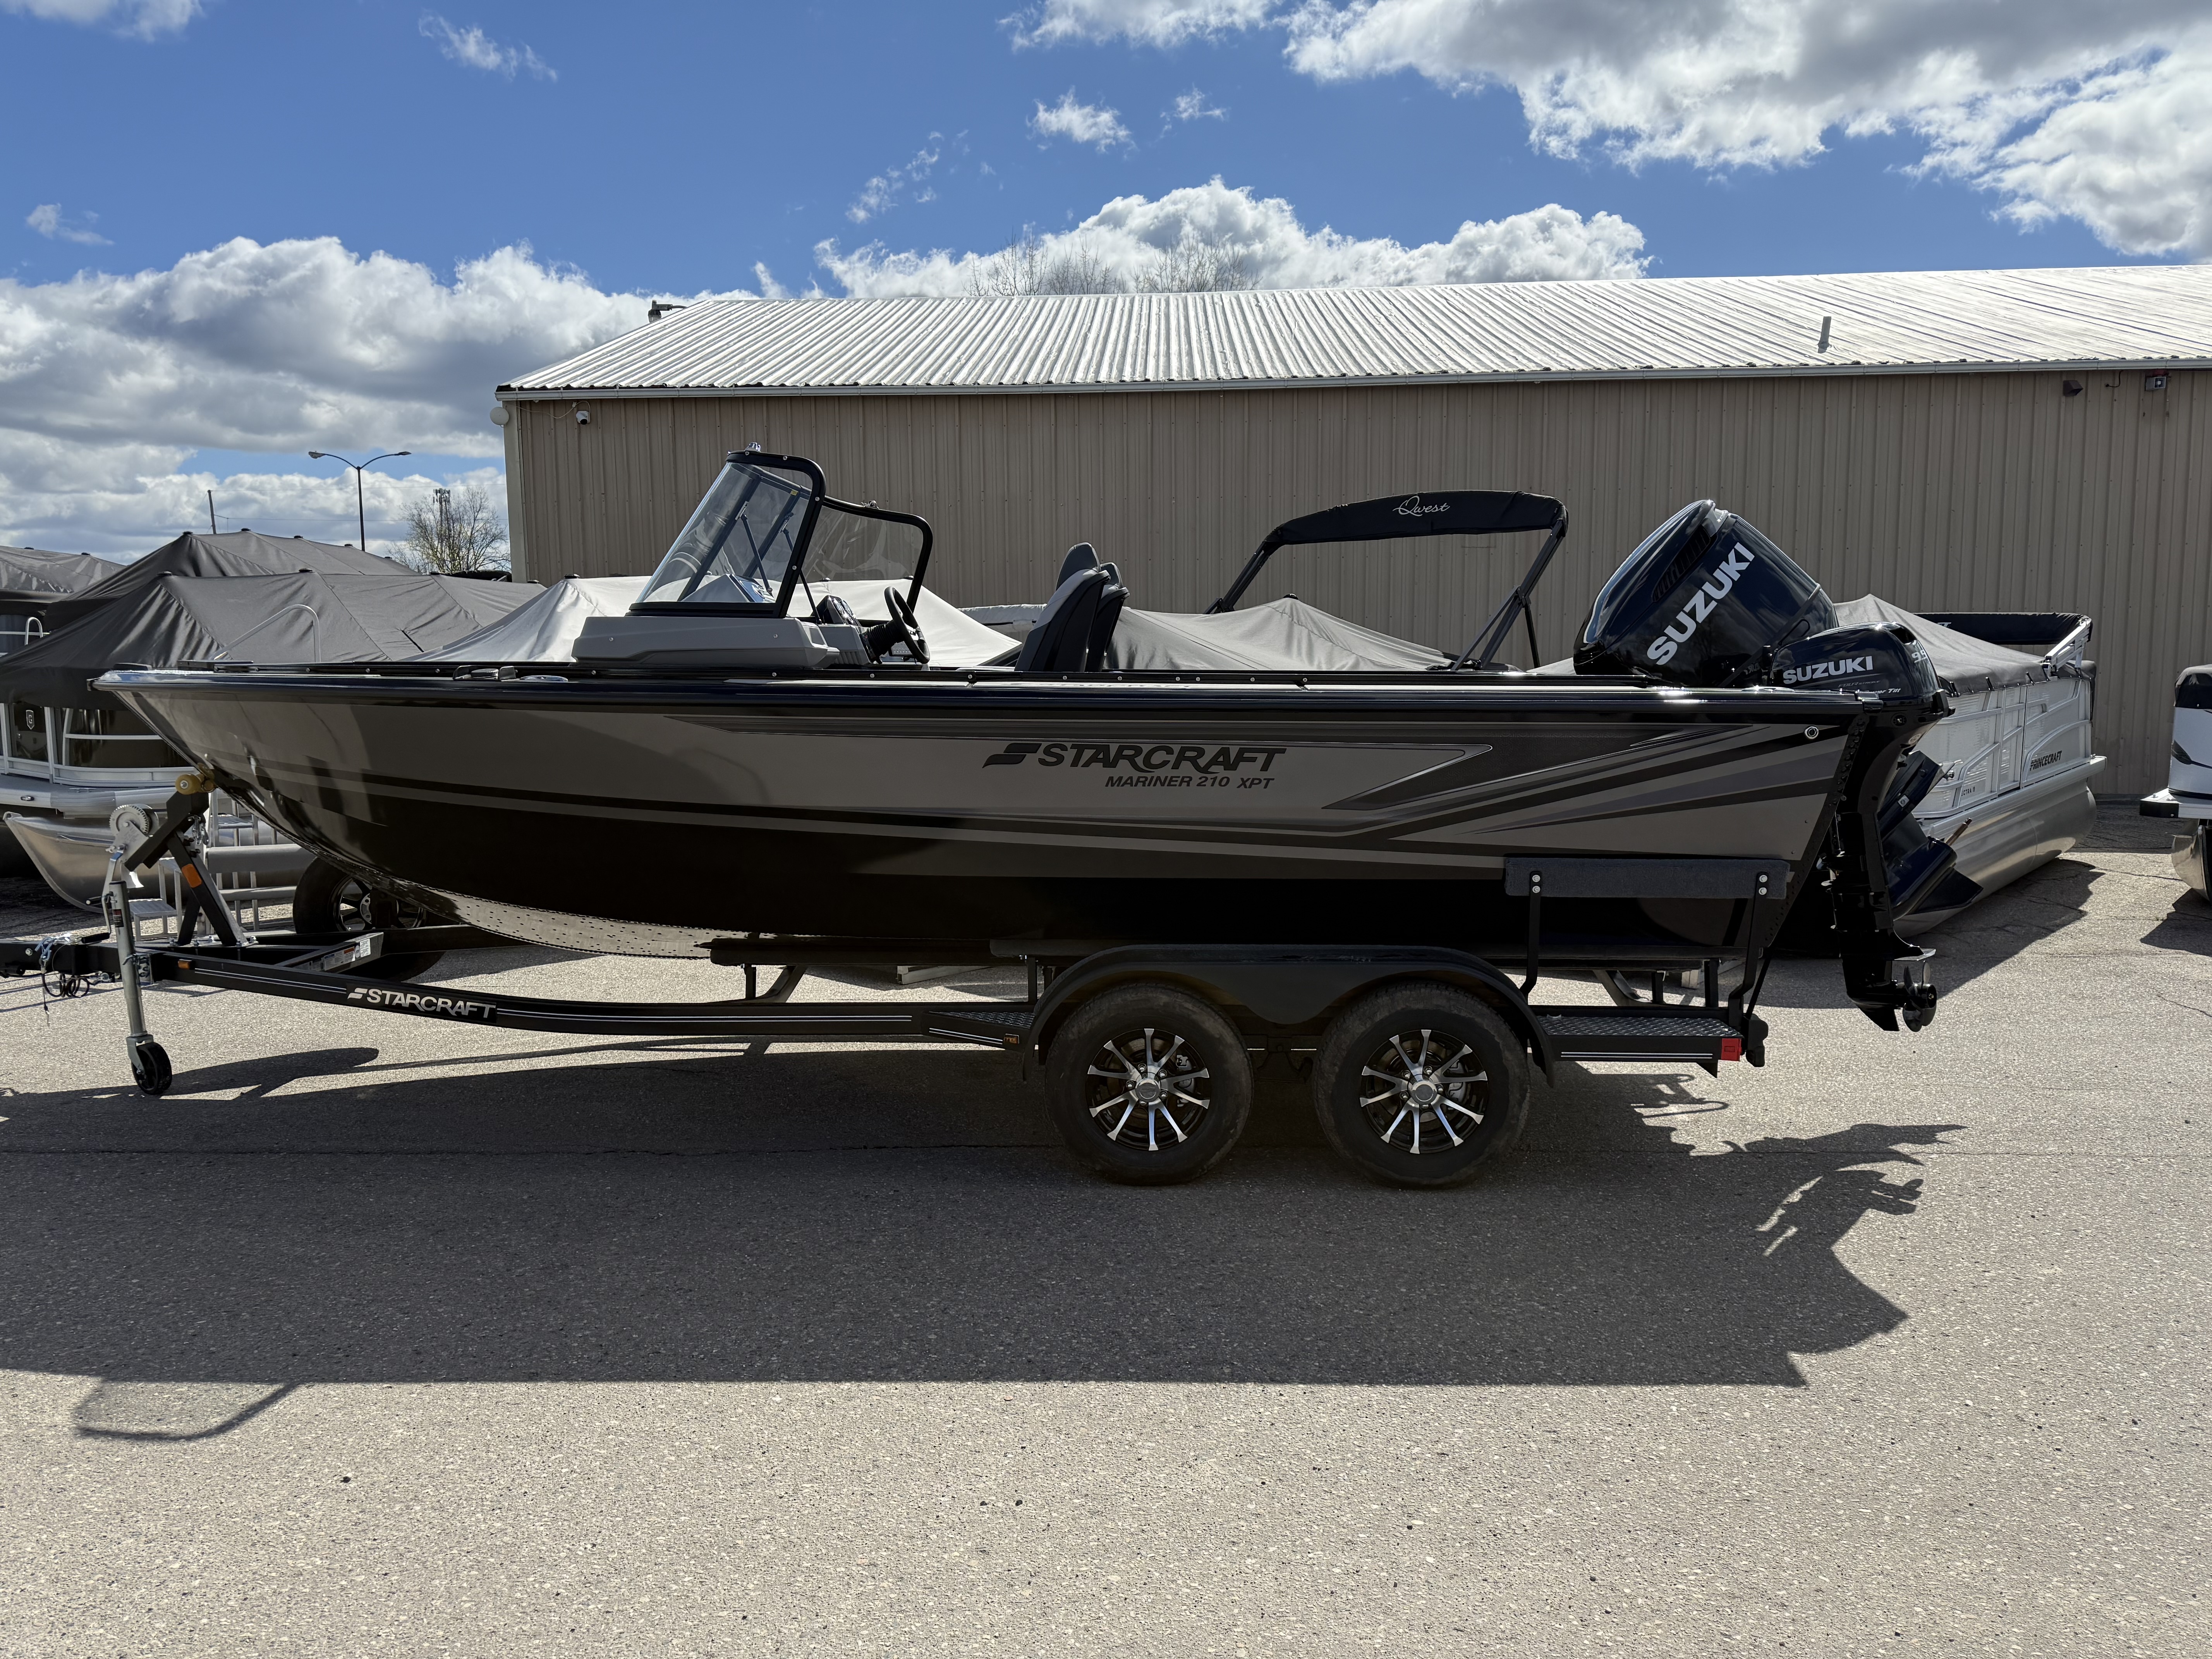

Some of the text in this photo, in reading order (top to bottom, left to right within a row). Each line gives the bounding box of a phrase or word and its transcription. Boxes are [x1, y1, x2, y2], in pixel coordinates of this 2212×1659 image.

[1393, 495, 1450, 517] Qwest
[1647, 542, 1755, 665] SUZUKI
[1783, 656, 1873, 684] SUZUKI
[1038, 743, 1287, 774] STARCRAFT
[2030, 750, 2062, 771] PRINCECRAFT
[1105, 776, 1274, 789] MARINER 210 XPT
[366, 989, 496, 1018] STARCRAFT
